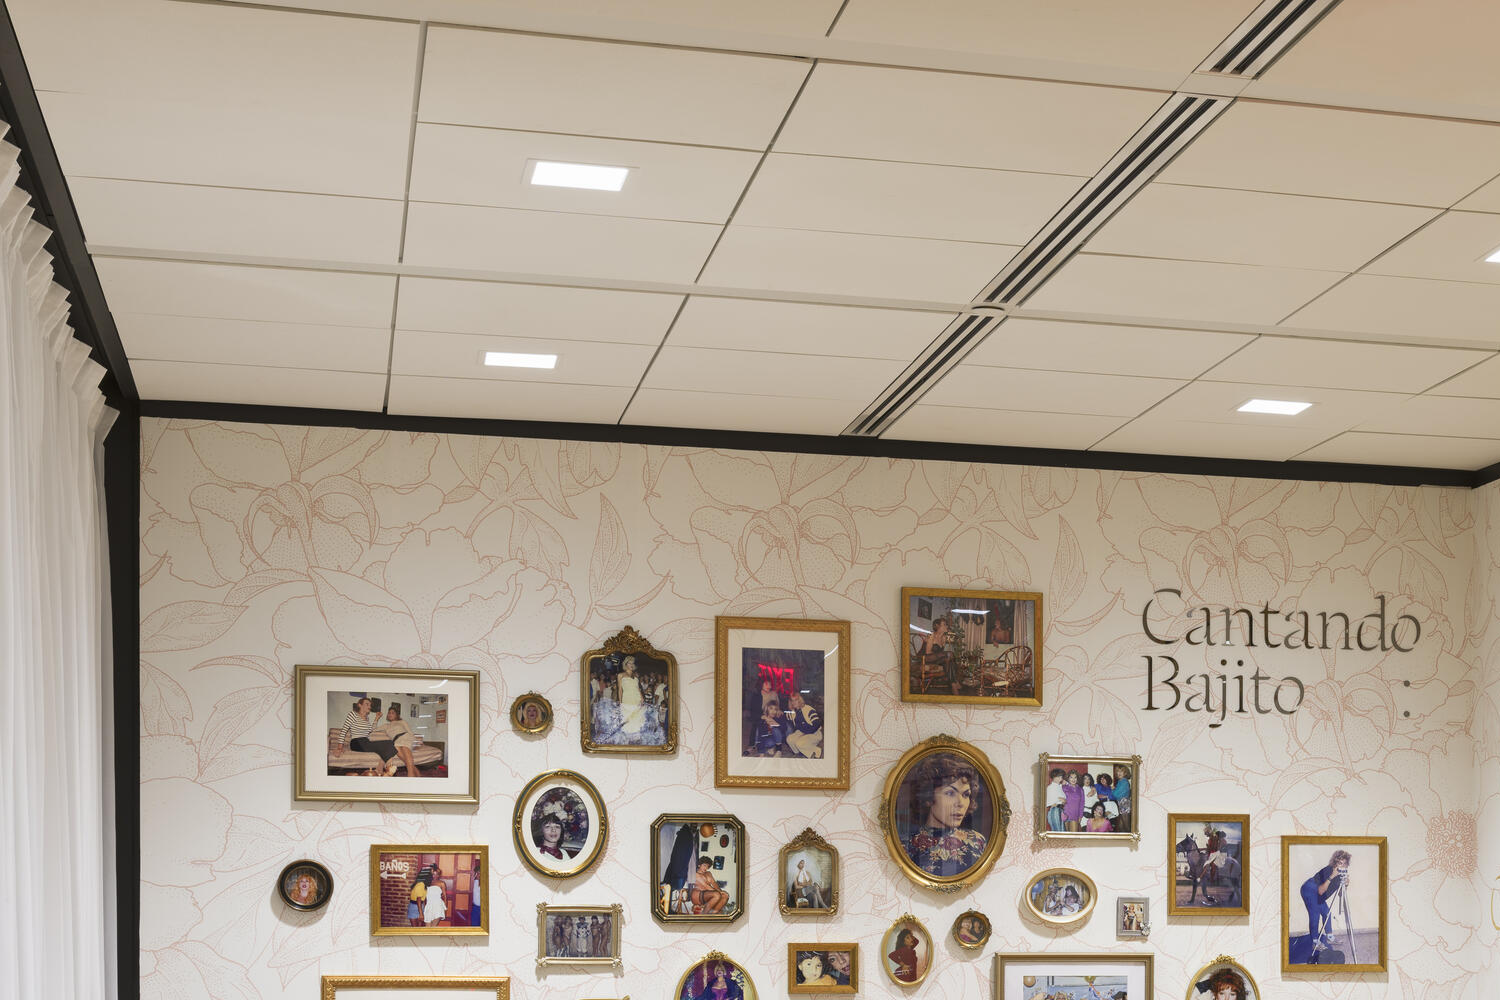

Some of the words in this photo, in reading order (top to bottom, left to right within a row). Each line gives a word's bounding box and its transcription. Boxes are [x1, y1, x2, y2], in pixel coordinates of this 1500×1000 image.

[1142, 588, 1421, 653] Cantando
[1141, 655, 1305, 729] Bajito
[380, 859, 409, 872] BAÑOS
